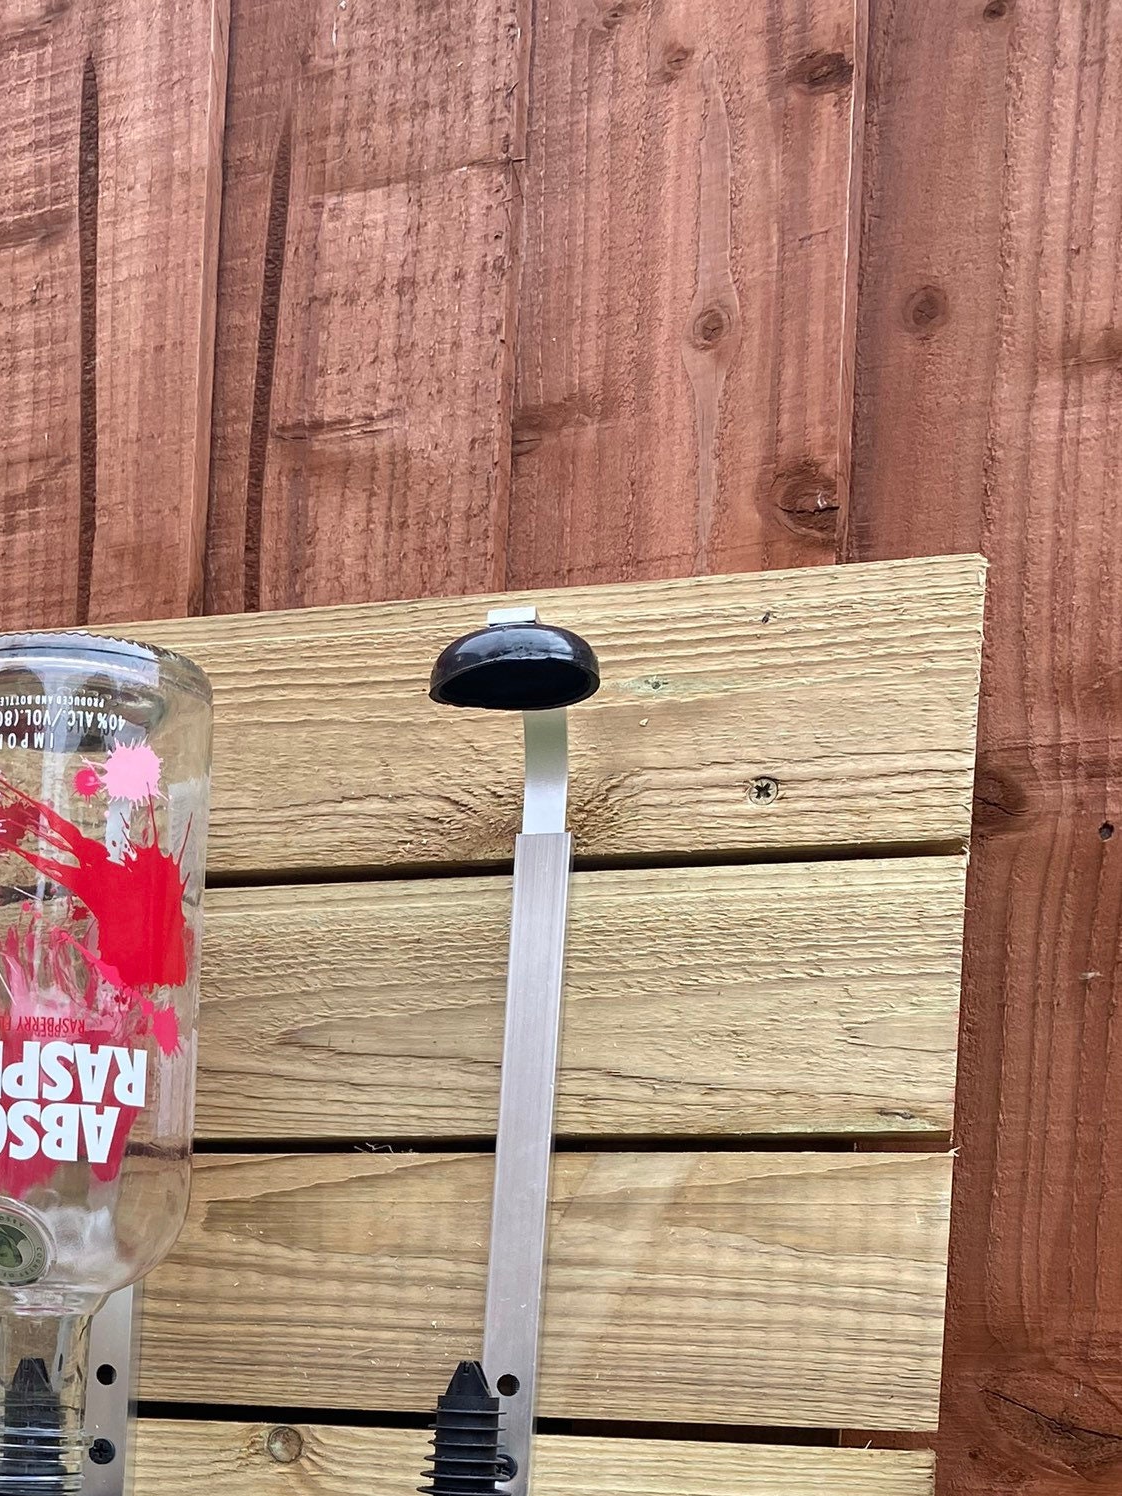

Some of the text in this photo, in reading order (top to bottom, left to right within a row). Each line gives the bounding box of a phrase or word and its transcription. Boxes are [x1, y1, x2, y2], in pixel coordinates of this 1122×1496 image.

[35, 694, 54, 704] AND
[56, 695, 104, 708] PRODUCED
[96, 712, 126, 731] 40%
[17, 1015, 85, 1033] RASPBERRY
